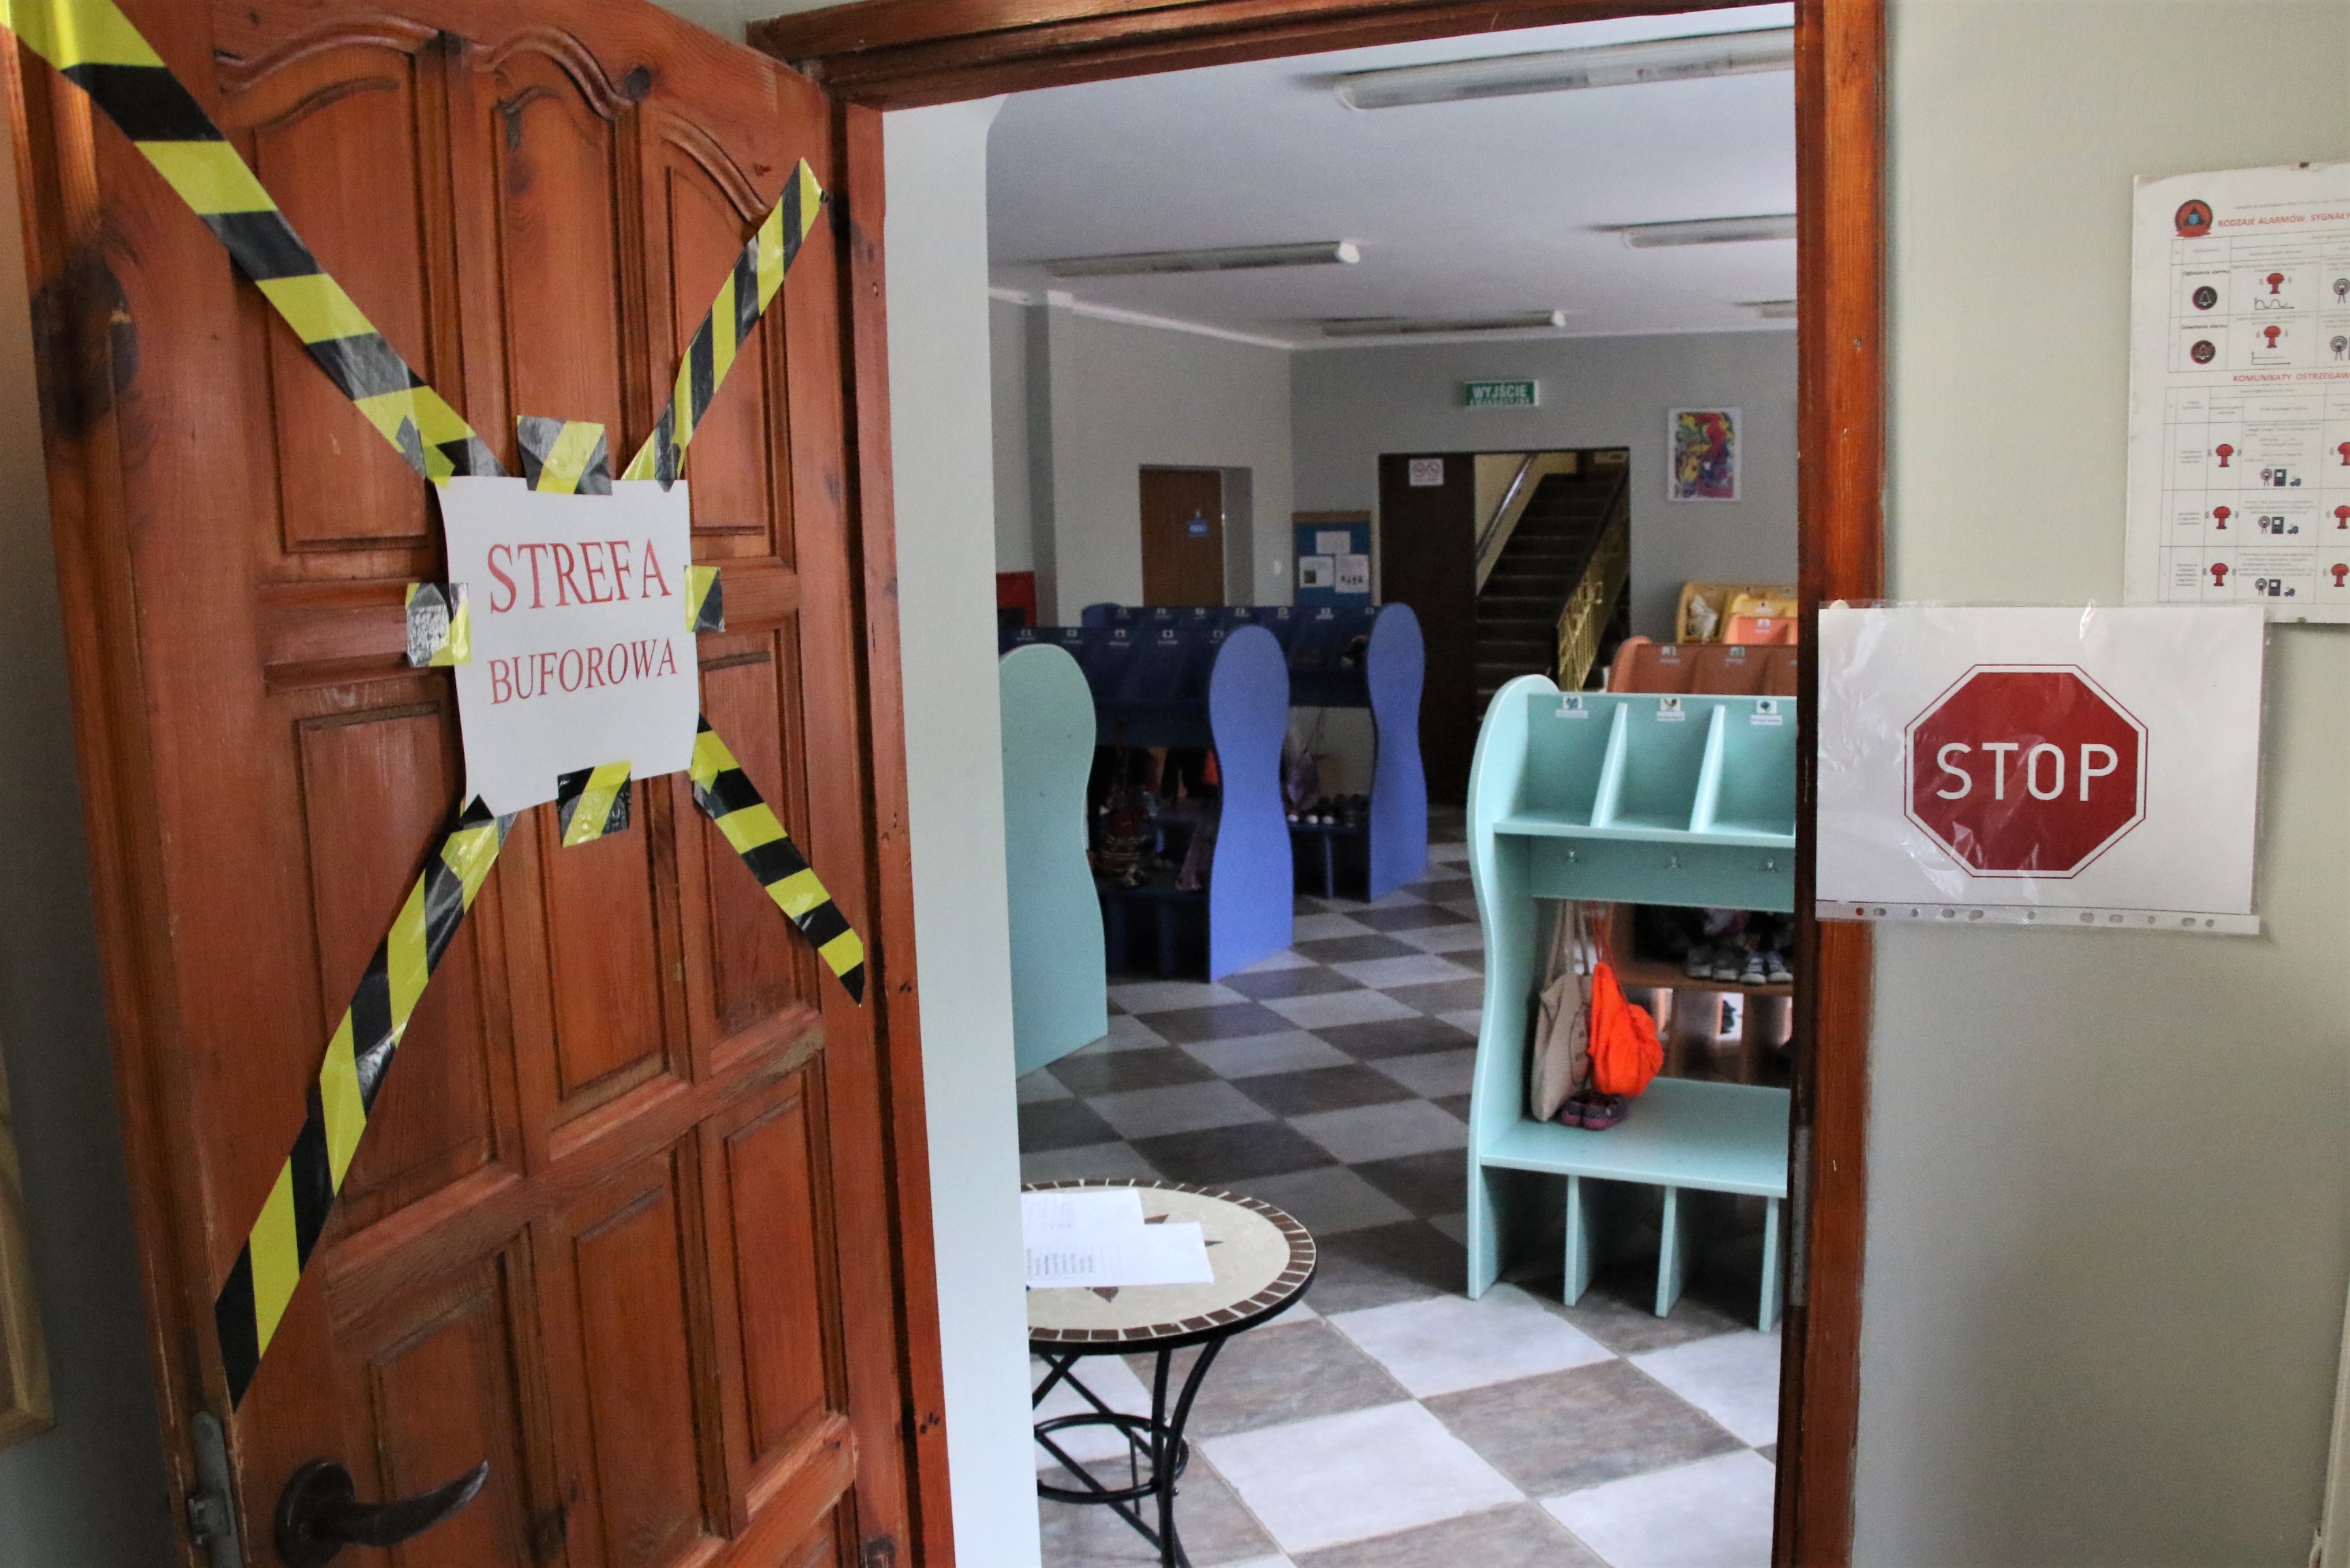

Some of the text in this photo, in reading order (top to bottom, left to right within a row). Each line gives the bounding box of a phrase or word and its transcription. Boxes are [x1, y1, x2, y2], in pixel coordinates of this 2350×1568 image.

[2218, 218, 2256, 227] RODZAJE
[487, 538, 672, 614] STREFA
[488, 638, 678, 705] BUFOROWA
[1936, 742, 2118, 802] STOP
